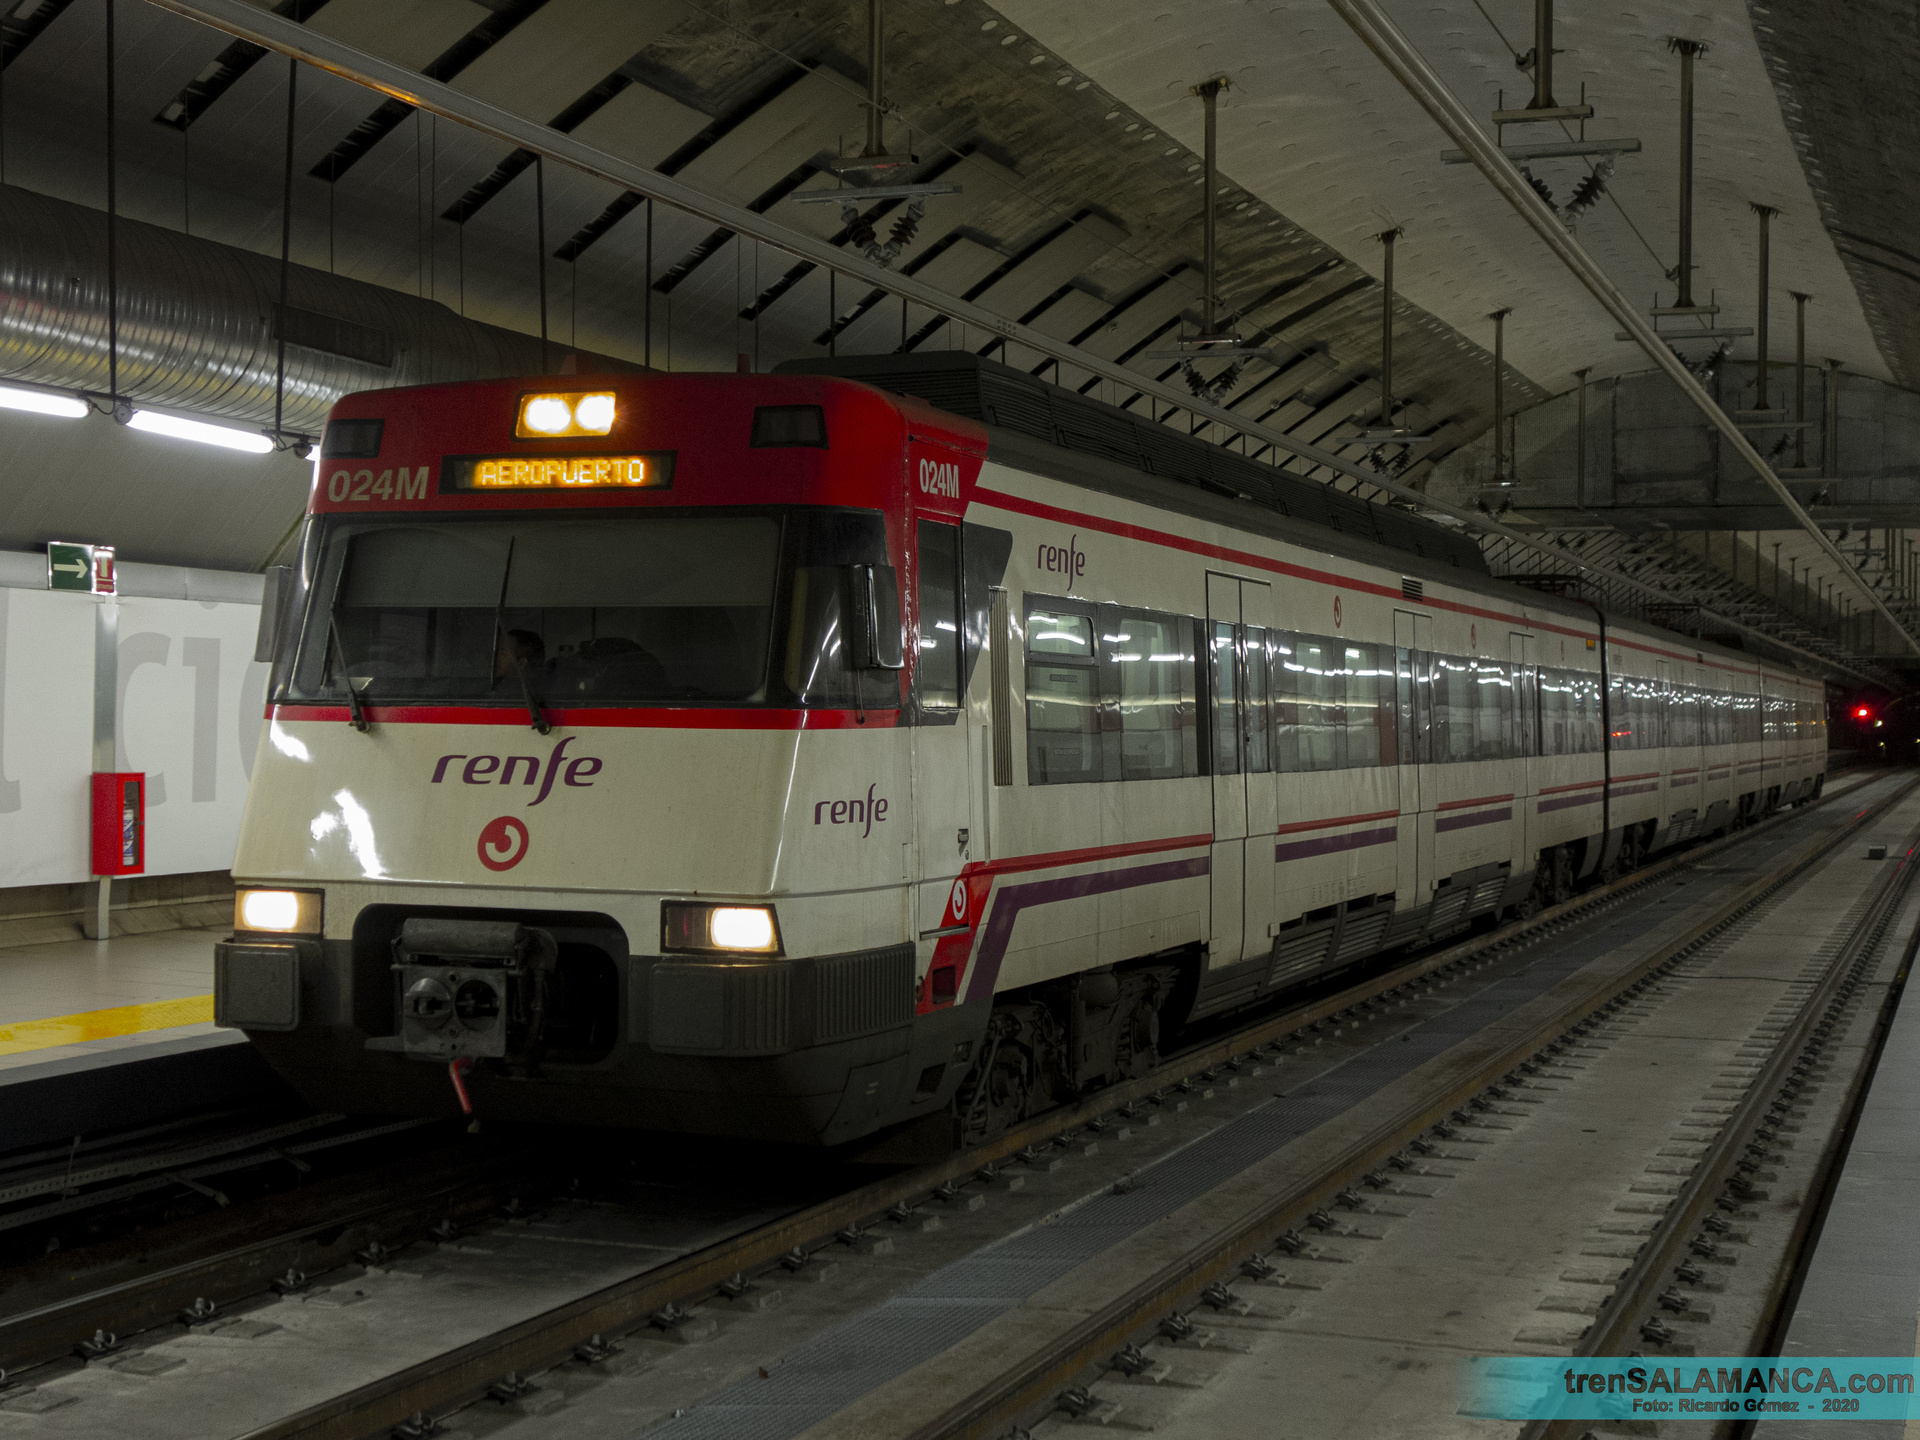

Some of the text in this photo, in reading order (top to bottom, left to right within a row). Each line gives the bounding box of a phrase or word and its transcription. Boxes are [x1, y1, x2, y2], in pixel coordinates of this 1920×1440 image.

[328, 466, 430, 503] 024M
[481, 459, 644, 486] AEROPUERTO
[919, 458, 960, 498] 024M
[1037, 533, 1086, 592] renfe
[431, 736, 603, 806] renfe
[814, 783, 889, 838] renfe
